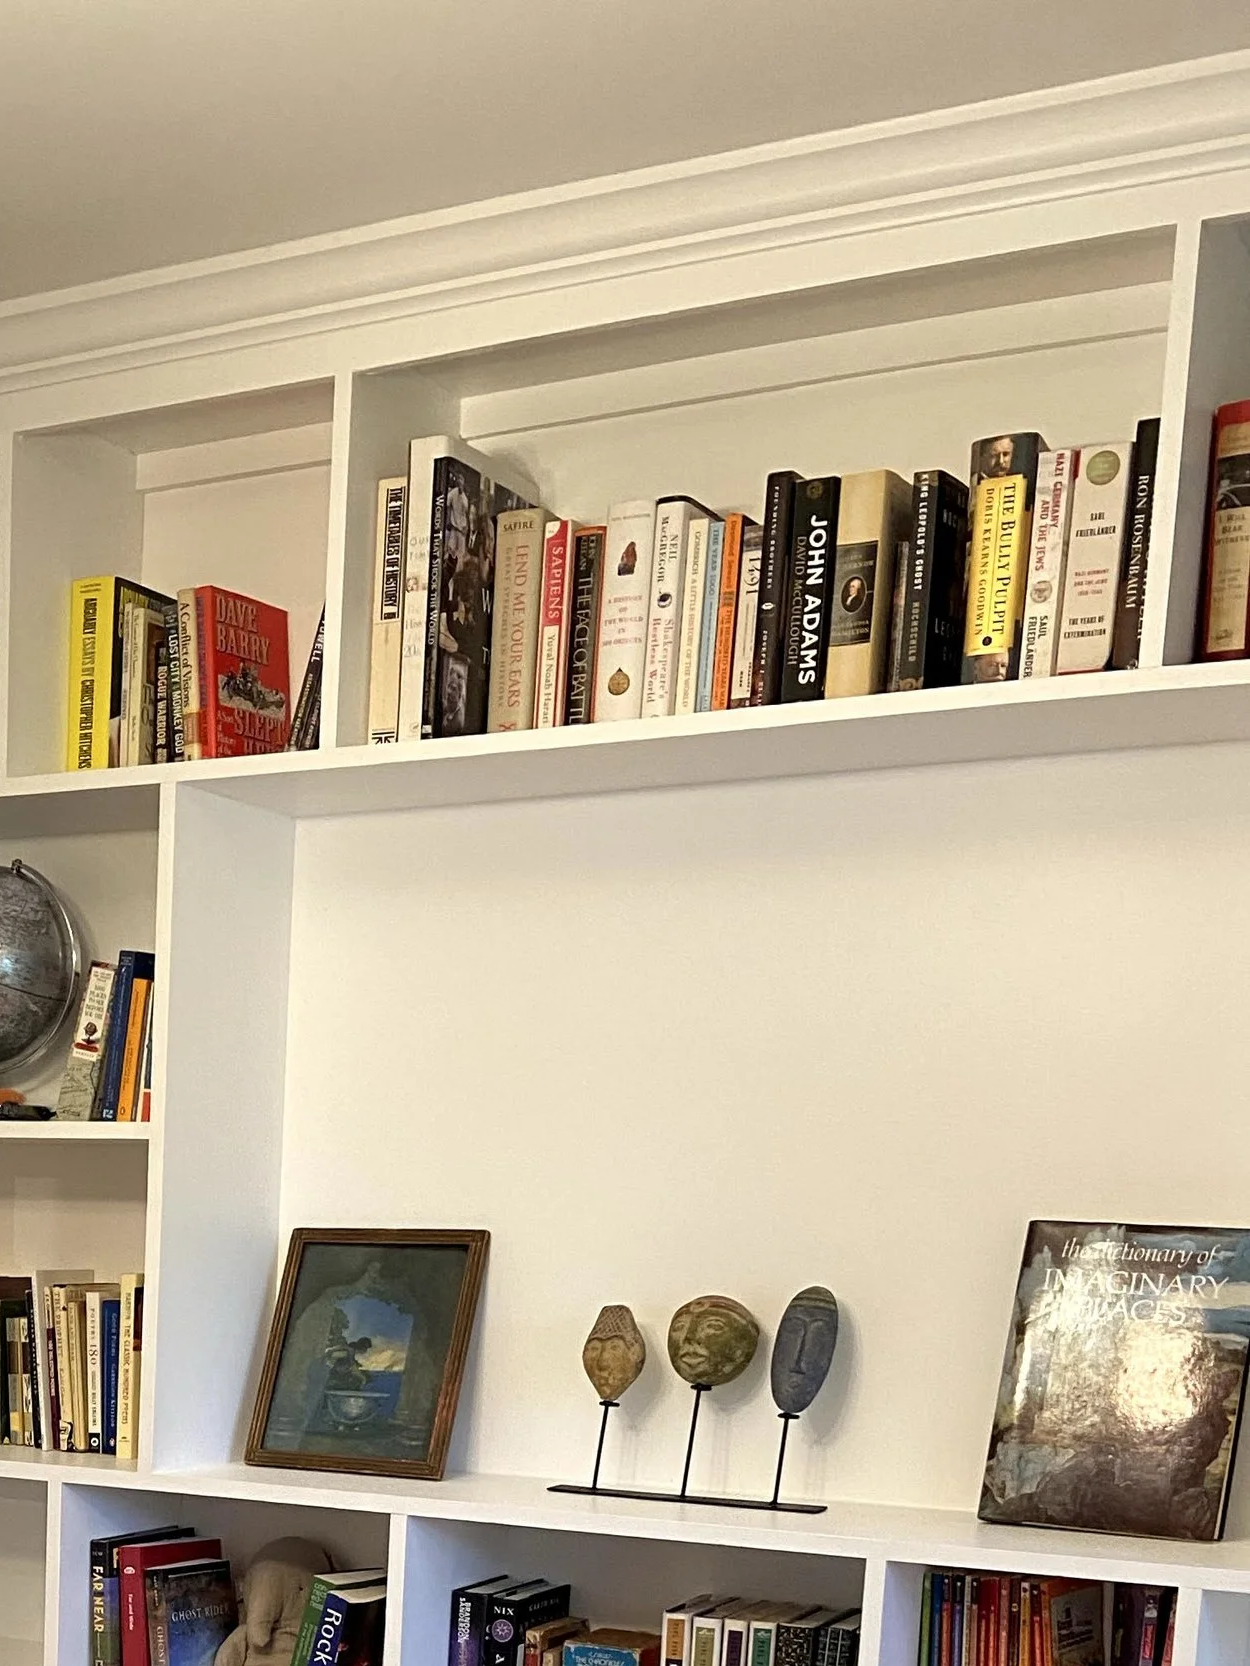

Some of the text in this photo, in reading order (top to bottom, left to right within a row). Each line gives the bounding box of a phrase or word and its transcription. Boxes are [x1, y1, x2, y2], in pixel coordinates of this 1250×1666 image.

[548, 546, 564, 618] SAPIENS
[975, 488, 995, 636] DORIS KEARNS GOODWIN
[992, 482, 1017, 634] THE BULLY PULPIT
[797, 514, 828, 685] JOHN ADAMS
[569, 671, 587, 724] BATTL
[92, 1566, 103, 1590] FAR
[93, 1596, 104, 1632] NEAR
